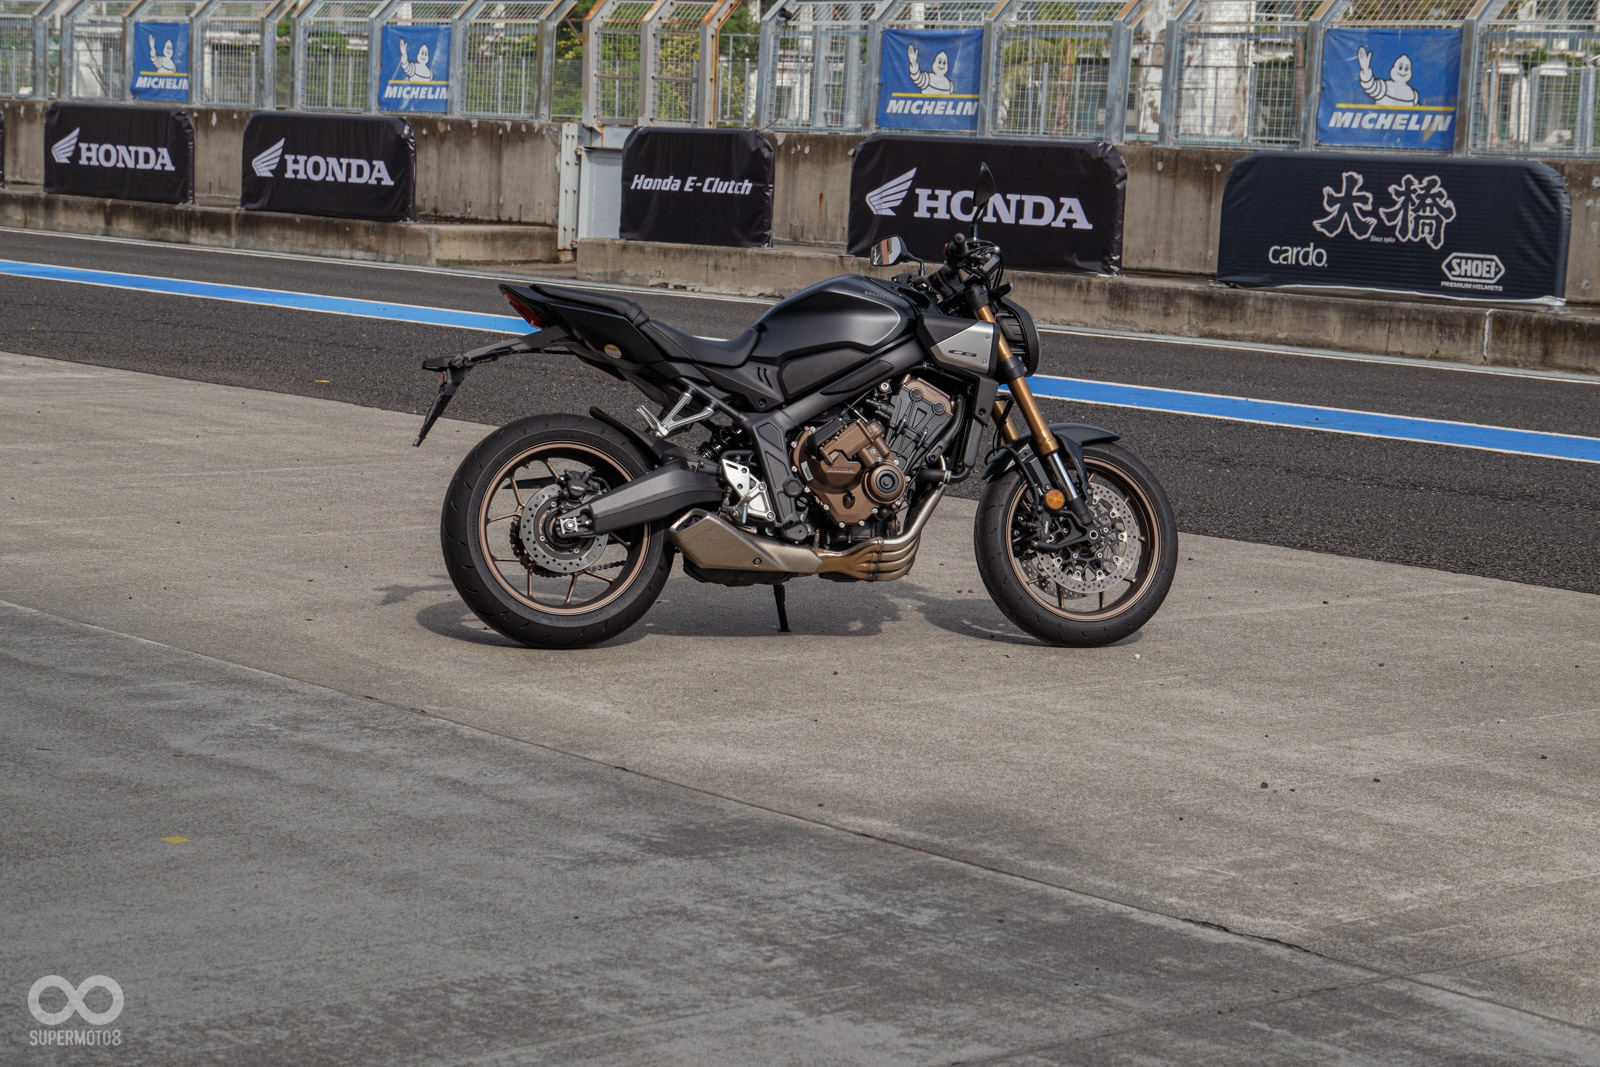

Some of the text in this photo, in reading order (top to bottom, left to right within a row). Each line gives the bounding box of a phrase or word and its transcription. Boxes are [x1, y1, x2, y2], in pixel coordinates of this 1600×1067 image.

[136, 77, 189, 90] MICHELIN
[384, 85, 449, 100] MICHELIN
[886, 99, 978, 116] MICHELIN
[1328, 111, 1452, 132] MICHELIN
[79, 143, 175, 171] HONDA
[285, 154, 394, 185] HONDA
[631, 174, 752, 195] Honda E-Clutch
[914, 188, 1093, 230] HONDA
[1313, 171, 1457, 250] 大橋
[1451, 258, 1496, 279] SHOEI
[1440, 281, 1503, 292] PREMIUM HELMETS
[948, 349, 977, 358] CB
